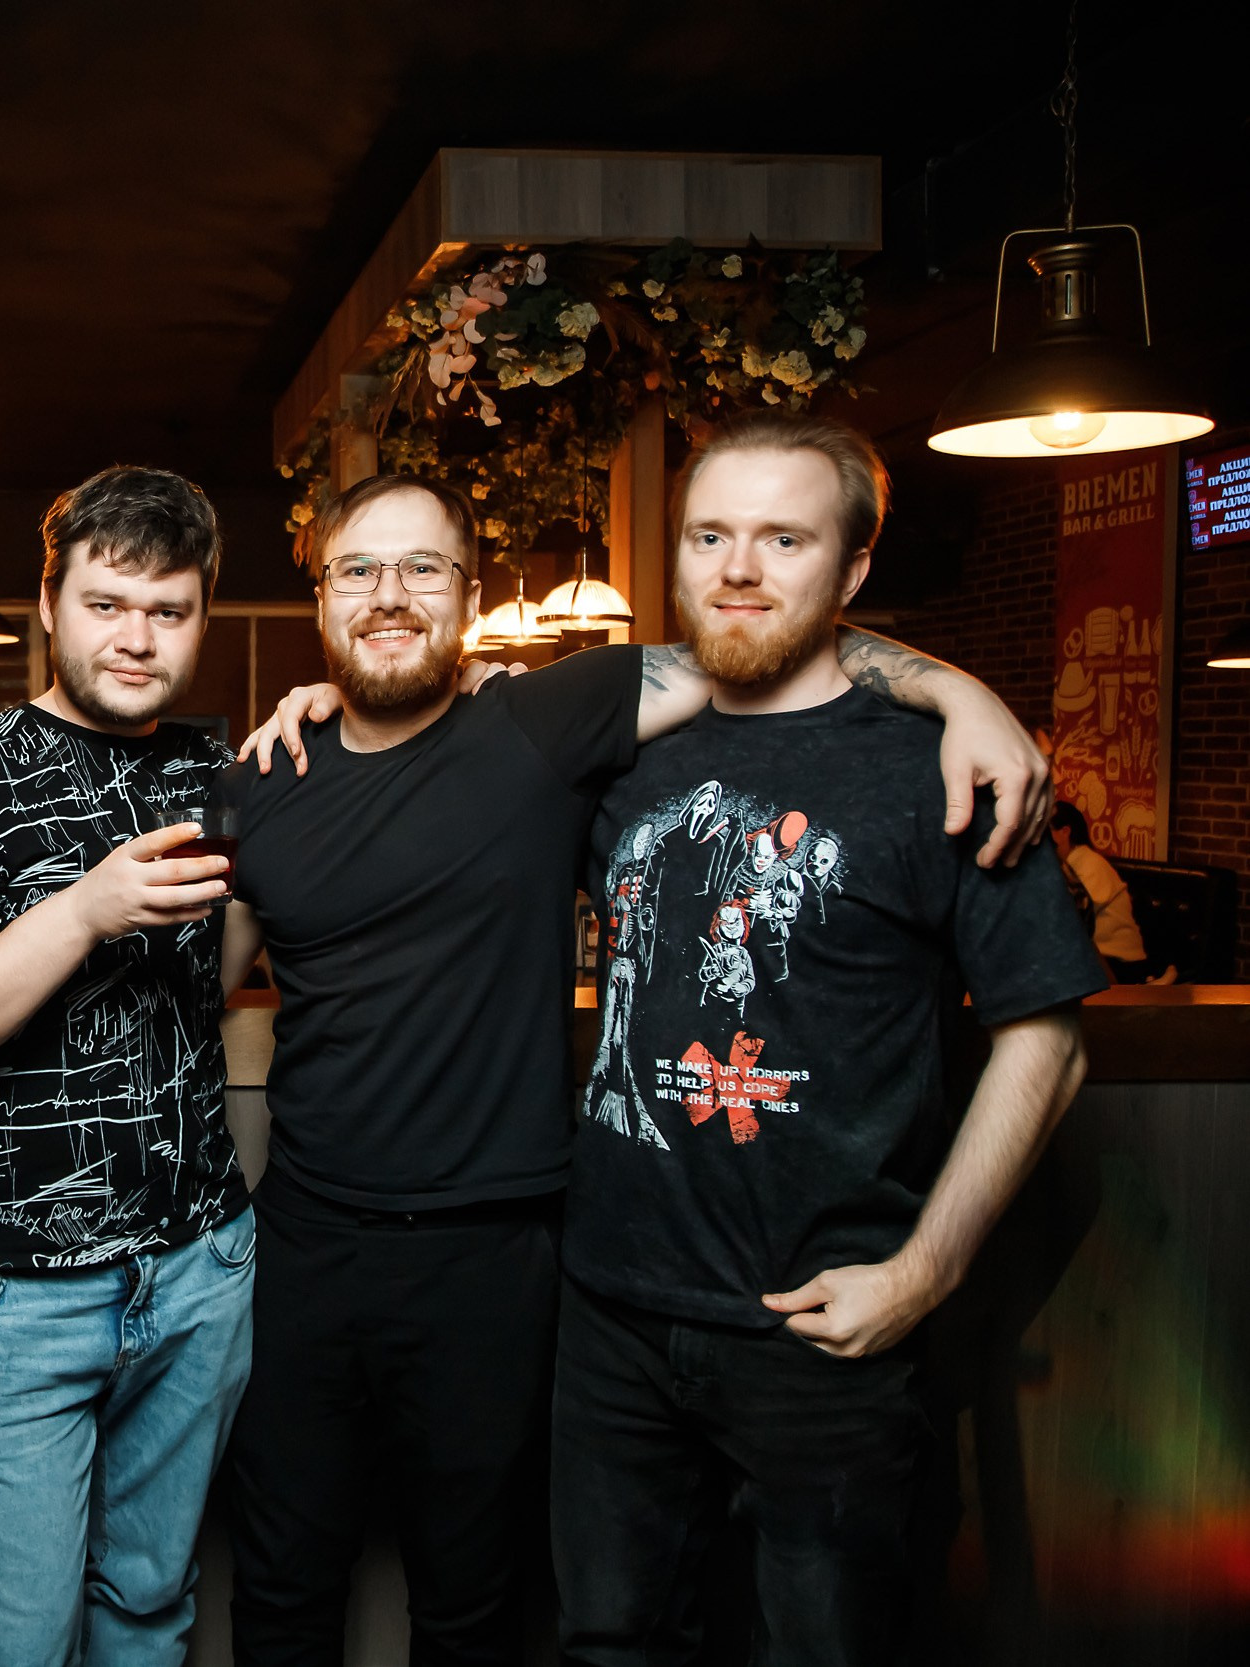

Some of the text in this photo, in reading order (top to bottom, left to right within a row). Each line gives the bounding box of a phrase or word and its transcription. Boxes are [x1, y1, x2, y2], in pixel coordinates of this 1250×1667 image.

[1063, 461, 1157, 515] BREMEN
[1062, 502, 1156, 537] BAR & GRILL
[655, 1058, 810, 1082] WE MAKE UP HORRORS
[656, 1073, 779, 1097] TO HELP US COPE
[655, 1089, 800, 1114] WITH THE REAL ONES
